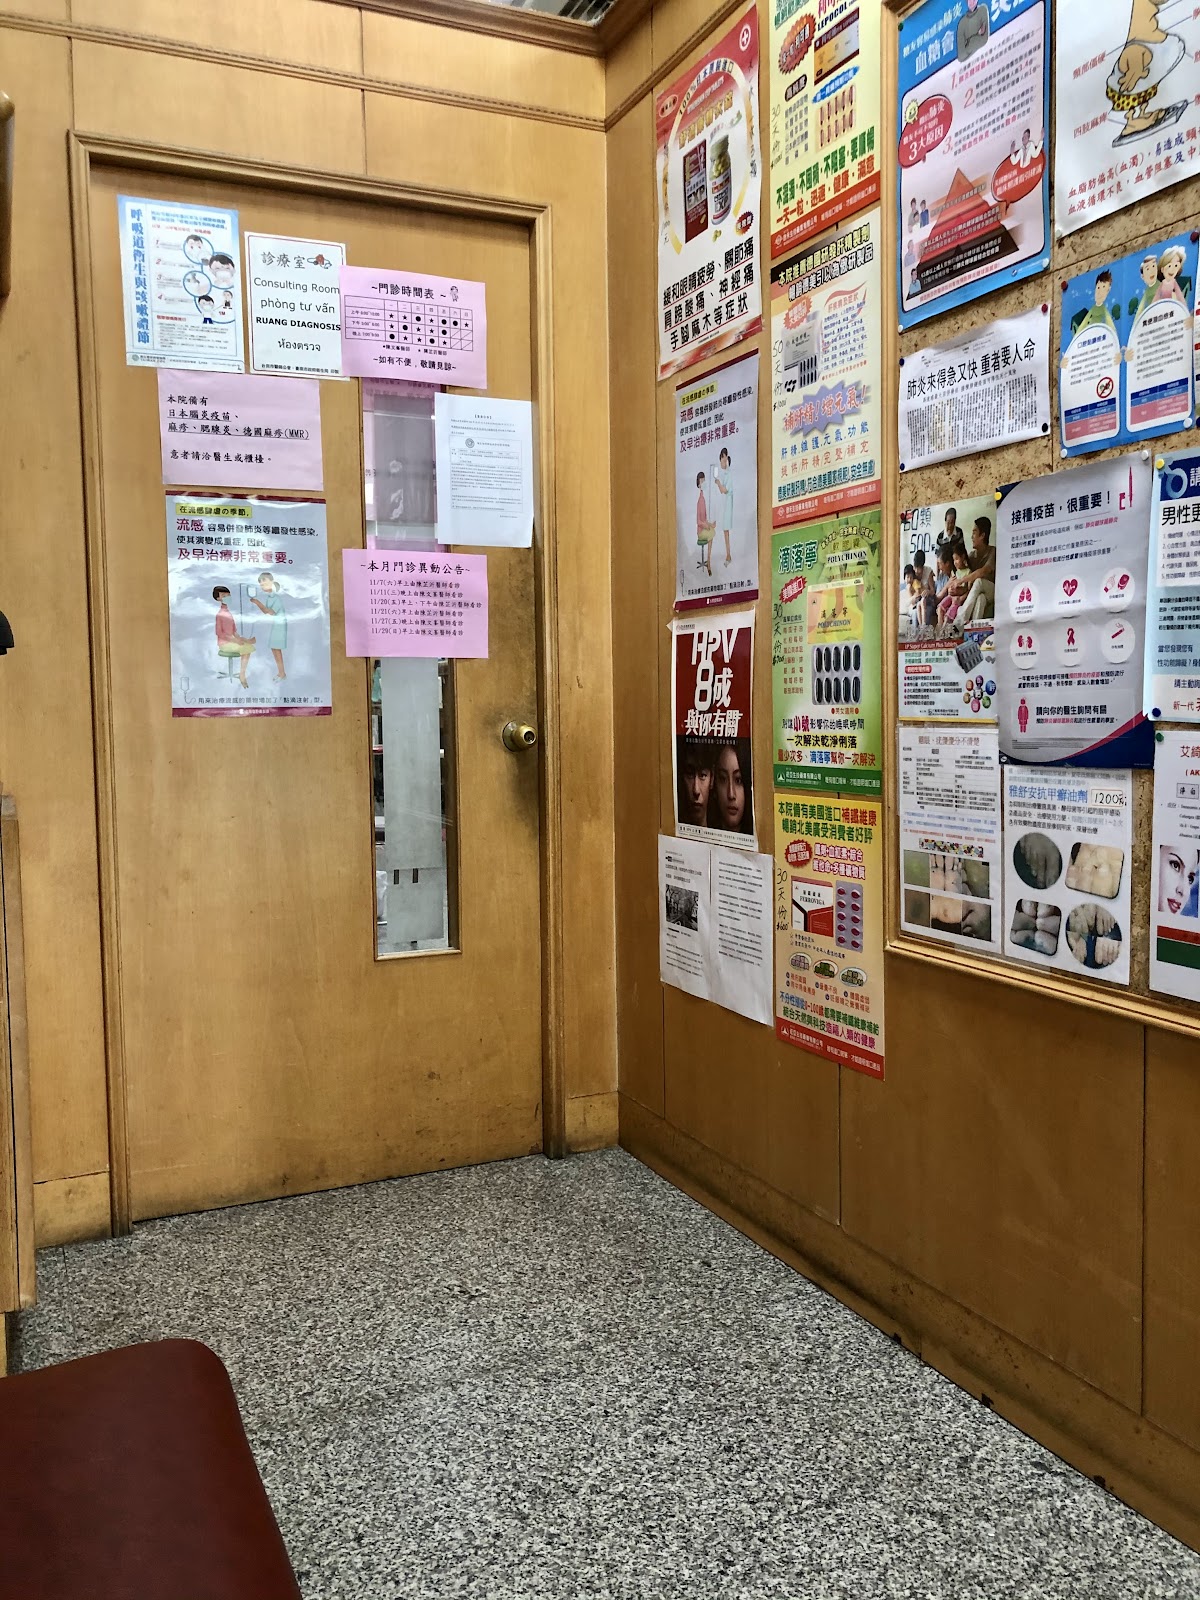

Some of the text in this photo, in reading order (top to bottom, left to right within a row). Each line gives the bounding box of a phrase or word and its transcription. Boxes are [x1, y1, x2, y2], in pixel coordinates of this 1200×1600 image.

[817, 1, 849, 32] LEPOCOL
[908, 124, 944, 161] 3大原因
[261, 252, 305, 269] 診療室
[130, 208, 150, 344] 呼吸道衛生與咳嗽禮節
[253, 277, 340, 294] Consulting Room
[260, 297, 296, 312] phòng
[300, 301, 312, 311] tư
[256, 316, 341, 331] RUANG DIAGNOSIS
[670, 292, 749, 350] 手腳麻木等症狀
[277, 338, 321, 351] ห้องตรวจ
[906, 357, 978, 400] 肺炎來得急又快
[980, 337, 1036, 377] 重者要人命
[167, 393, 209, 407] 本院備有
[680, 406, 694, 423] 流感
[680, 420, 740, 453] 及早治療非常重要。
[1011, 490, 1111, 526] 接種疫苗，很重要！
[176, 518, 205, 532] 流感
[177, 547, 294, 565] 及早治療非常重要。
[827, 550, 867, 564] POLYCHINON
[691, 627, 739, 666] HPV
[694, 659, 734, 712] 8成
[1172, 700, 1195, 712] 新一代
[684, 708, 744, 738] 與你有關
